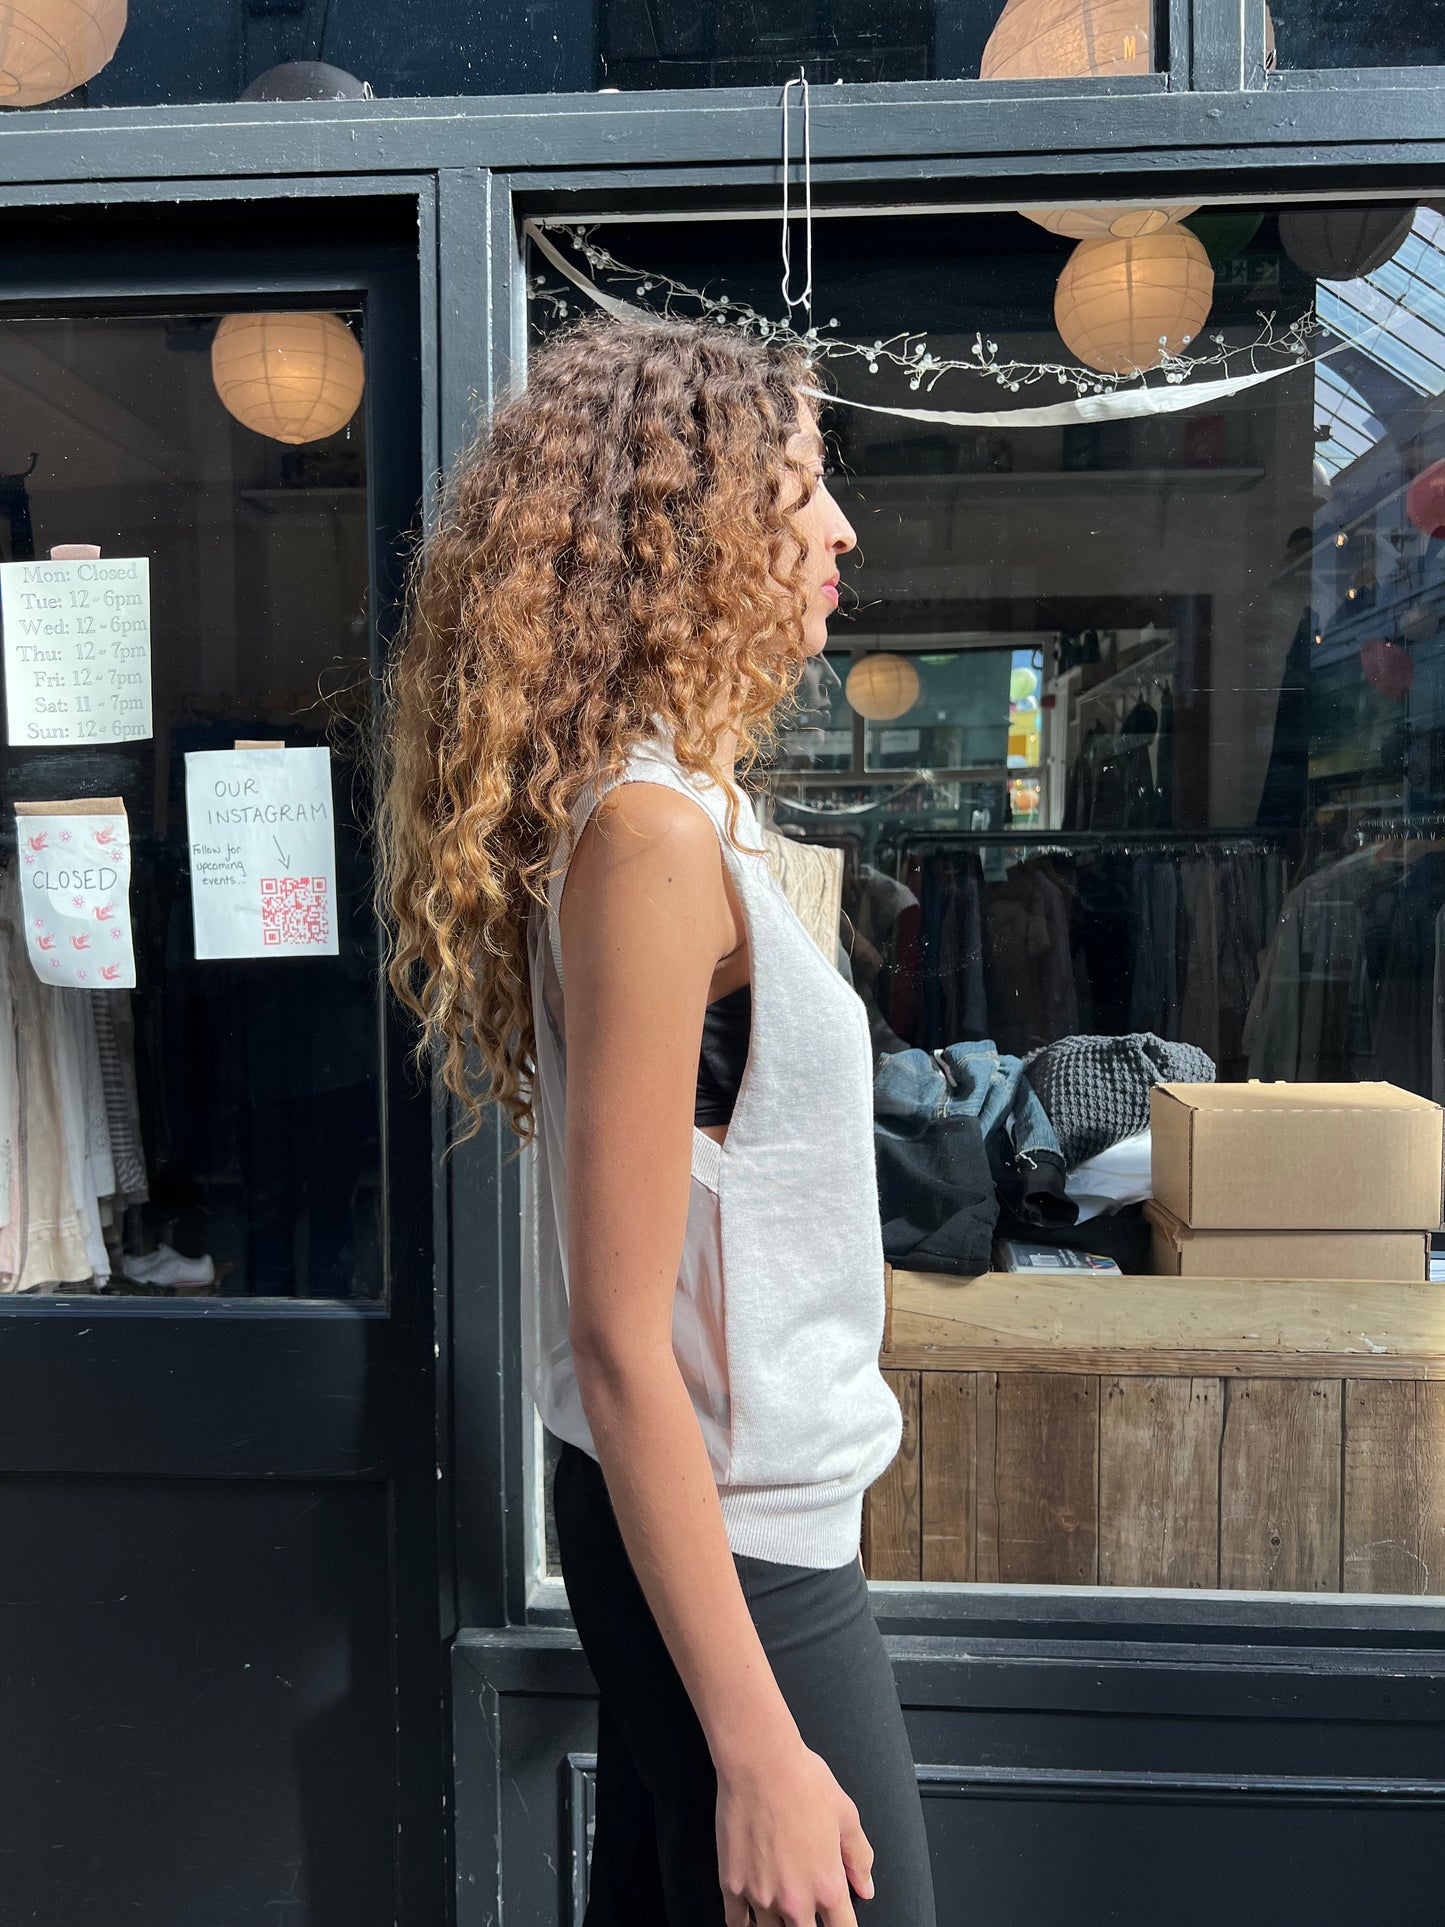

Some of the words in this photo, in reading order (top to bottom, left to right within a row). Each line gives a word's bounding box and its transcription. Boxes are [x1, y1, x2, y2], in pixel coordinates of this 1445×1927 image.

[23, 566, 70, 584] Mon:
[77, 563, 138, 582] Closed
[20, 593, 62, 609] Tue:
[18, 618, 70, 636] Wed:
[16, 645, 62, 662] Thu:
[33, 671, 65, 687] Fri:
[34, 697, 68, 714] Sat:
[27, 723, 69, 739] Sun:
[214, 778, 259, 798] OUR
[207, 802, 327, 825] INSTAGRAM
[193, 843, 221, 857] Follow
[227, 842, 242, 862] for
[196, 860, 246, 877] upcoming
[32, 867, 118, 891] CLOSED
